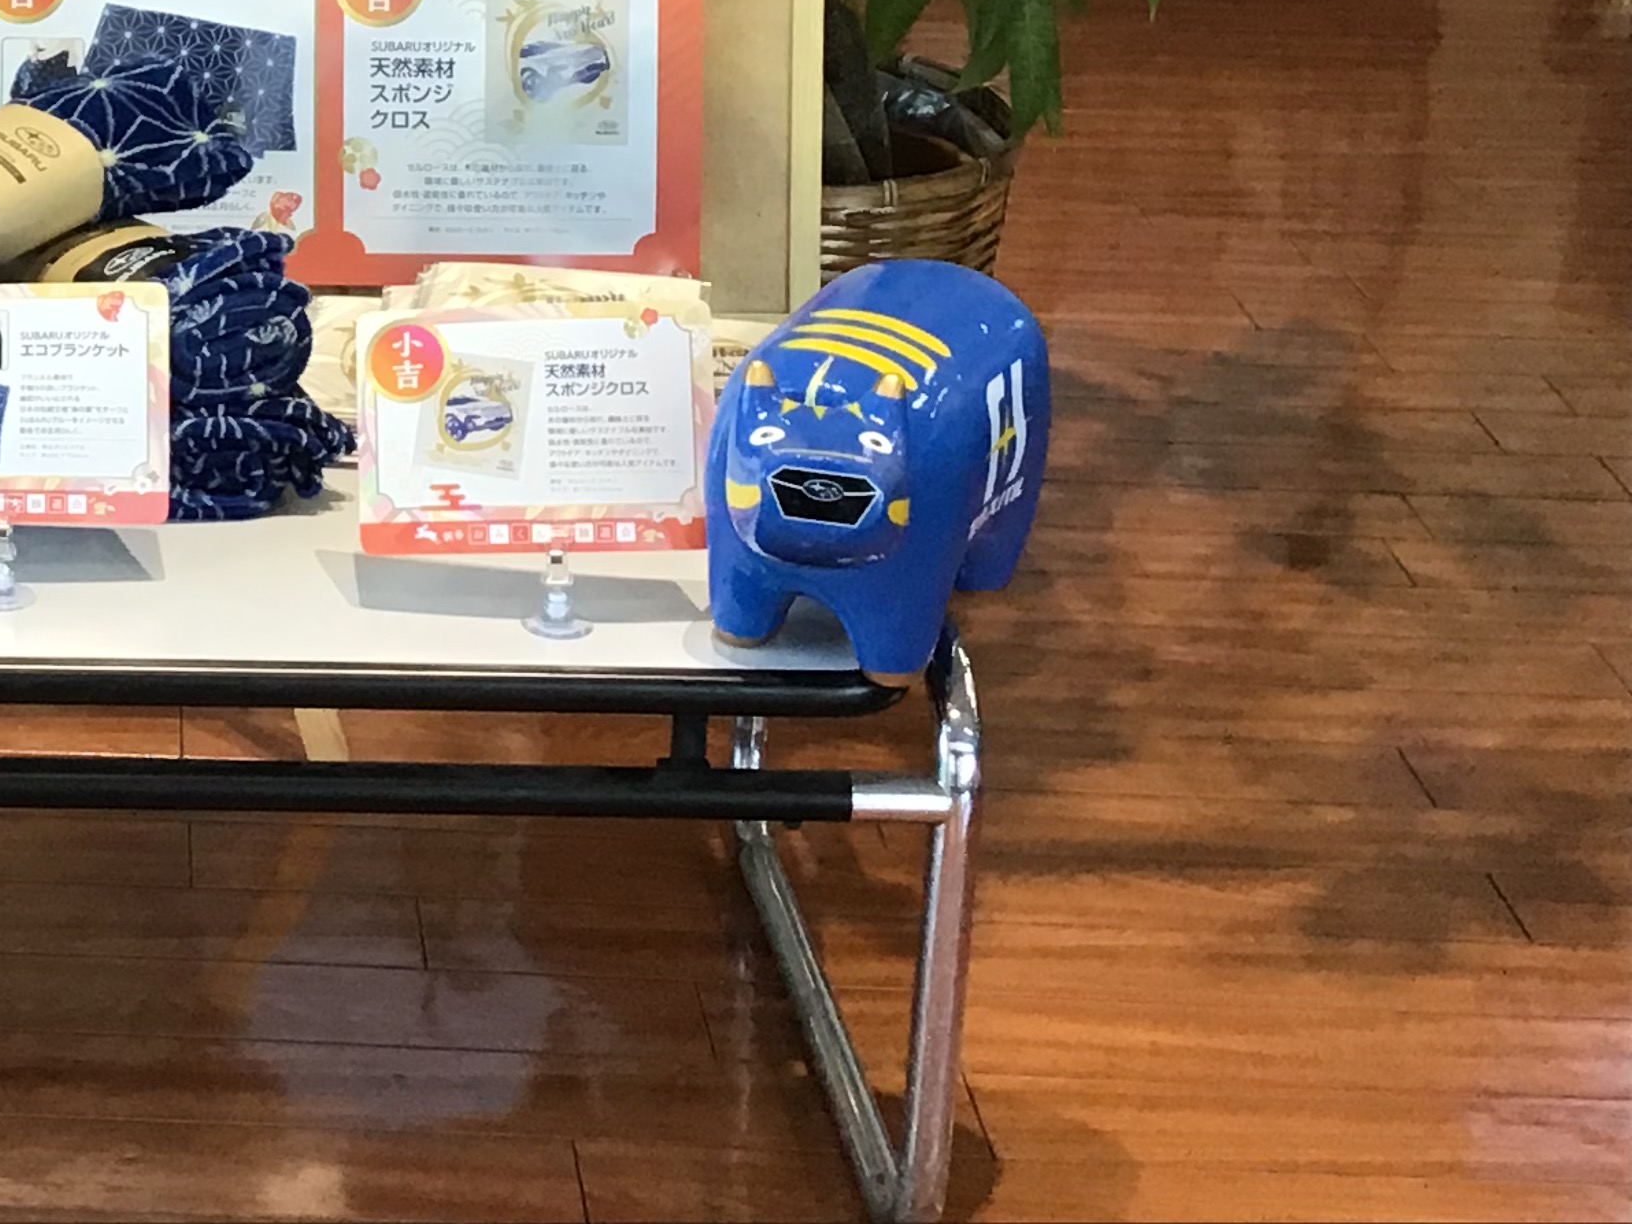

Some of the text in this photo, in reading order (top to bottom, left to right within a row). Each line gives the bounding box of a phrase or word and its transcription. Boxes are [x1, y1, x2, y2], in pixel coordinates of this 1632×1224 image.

[371, 40, 476, 54] SUBARUオリジナル
[369, 57, 456, 78] 天然素材
[370, 83, 453, 104] スポンジ
[370, 110, 431, 130] クロス
[20, 330, 111, 341] SUBARUオリジナル
[20, 343, 130, 358] エコブランケット
[544, 349, 639, 361] SUBARUオリジナル
[392, 331, 424, 390] 小吉
[544, 363, 606, 378] 天然素材
[545, 381, 650, 397] スポンジクロス
